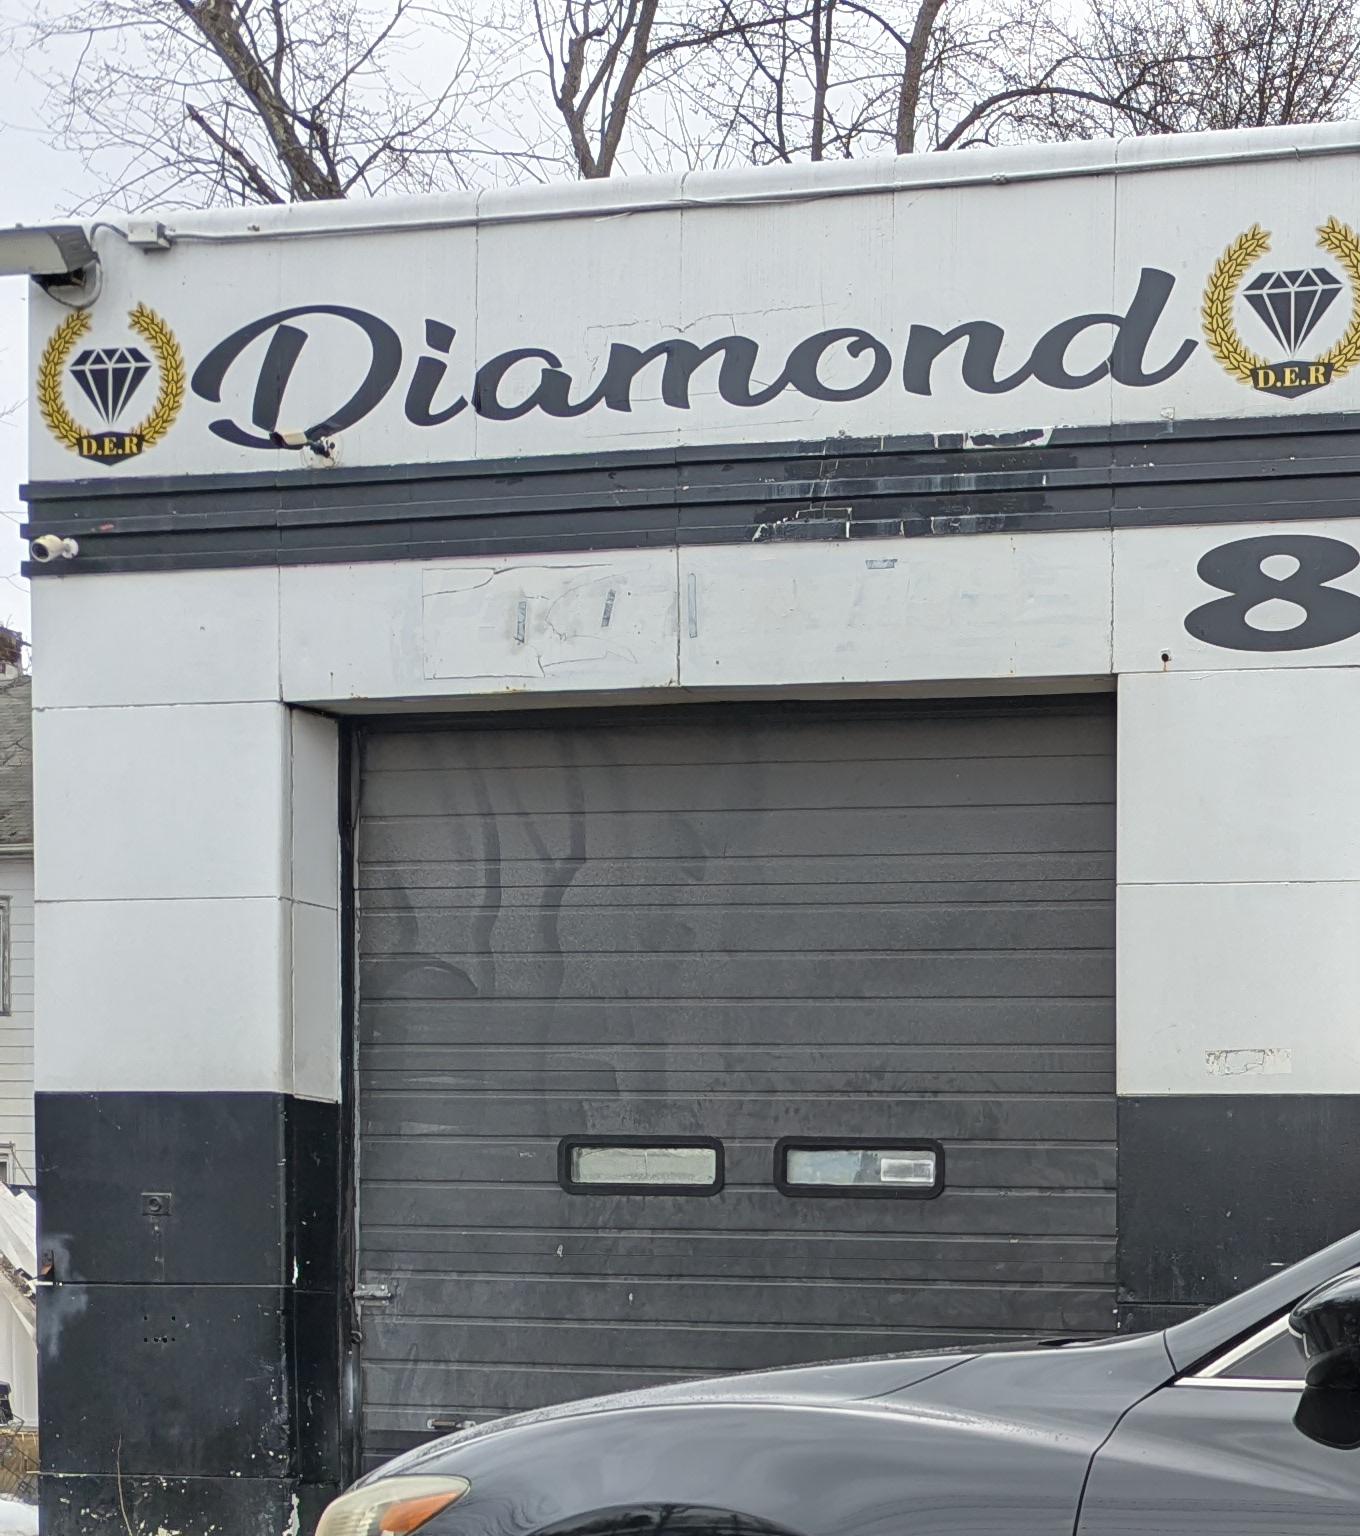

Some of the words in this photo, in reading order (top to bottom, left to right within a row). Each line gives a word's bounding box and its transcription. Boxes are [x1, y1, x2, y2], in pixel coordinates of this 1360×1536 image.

[191, 267, 1199, 450] Diamond
[1256, 364, 1327, 389] D.E.R
[82, 436, 139, 456] D.E.R
